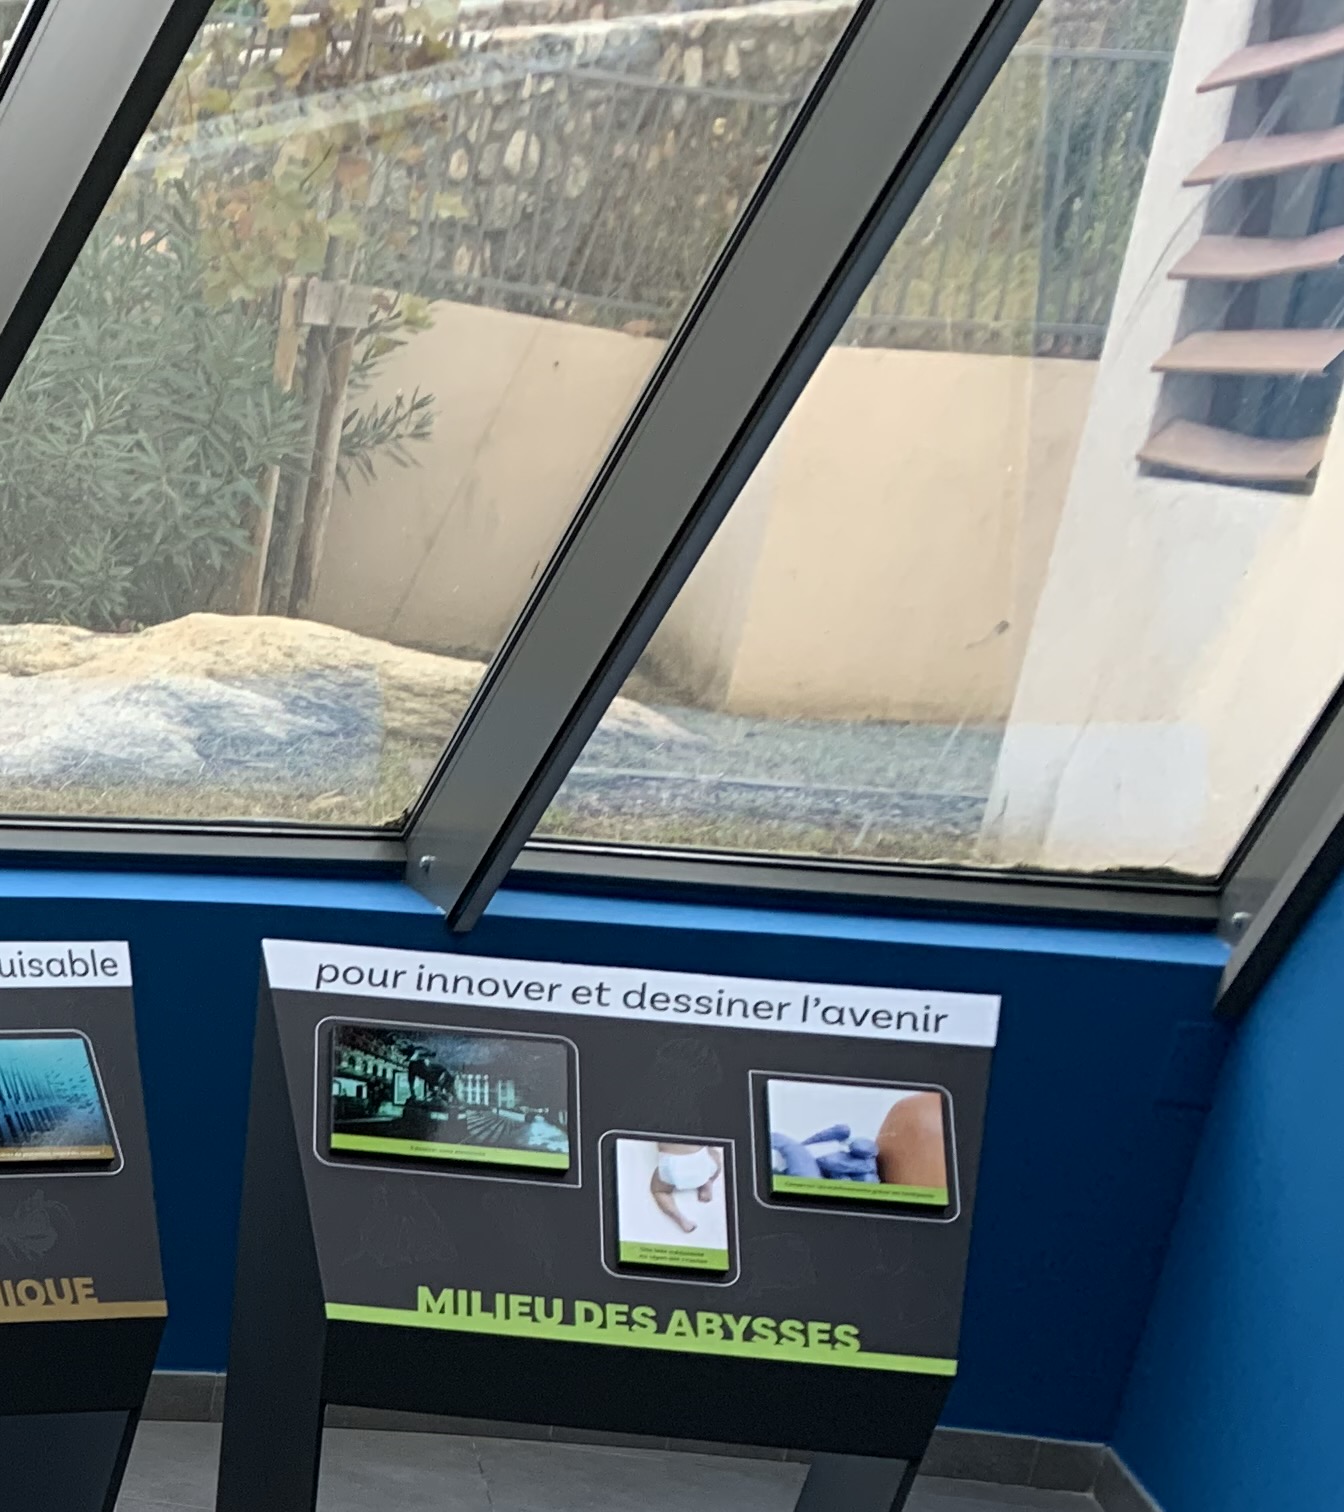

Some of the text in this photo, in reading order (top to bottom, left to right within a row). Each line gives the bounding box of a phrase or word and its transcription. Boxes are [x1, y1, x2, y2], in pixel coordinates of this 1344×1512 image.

[315, 963, 949, 1033] pour innover et dessiner l'avenir
[415, 1285, 862, 1354] MILIEU DES ABYSSES
